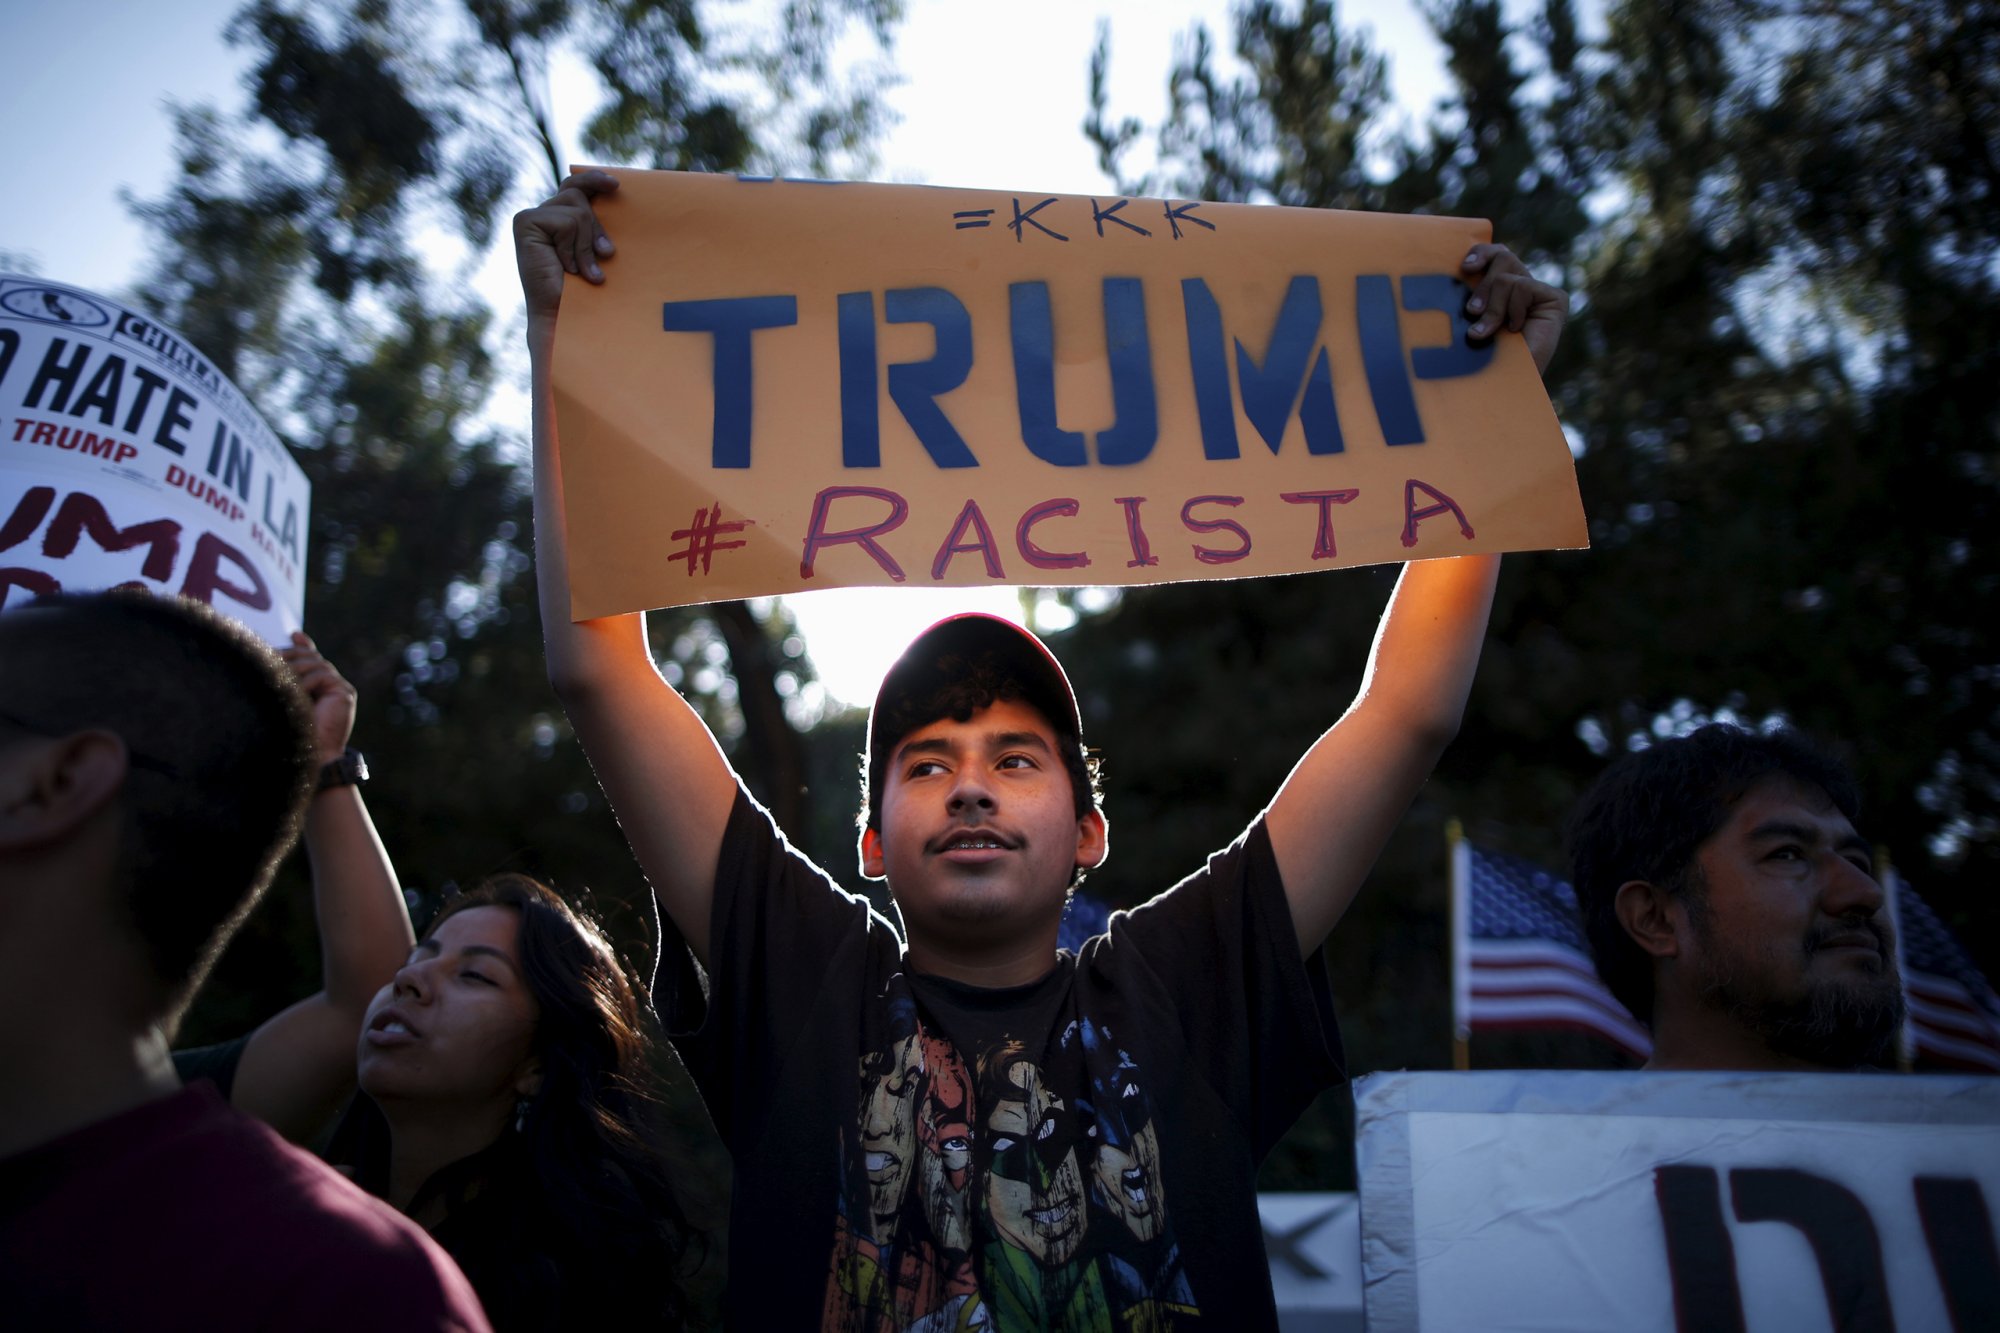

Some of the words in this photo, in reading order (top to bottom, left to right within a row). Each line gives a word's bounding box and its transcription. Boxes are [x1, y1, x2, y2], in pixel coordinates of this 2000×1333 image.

[21, 337, 198, 457] HATE
[206, 418, 254, 502] IN
[263, 471, 298, 565] LA
[663, 274, 1496, 468] TRUMP
[13, 418, 138, 463] TRUMP
[165, 463, 246, 521] DUMP
